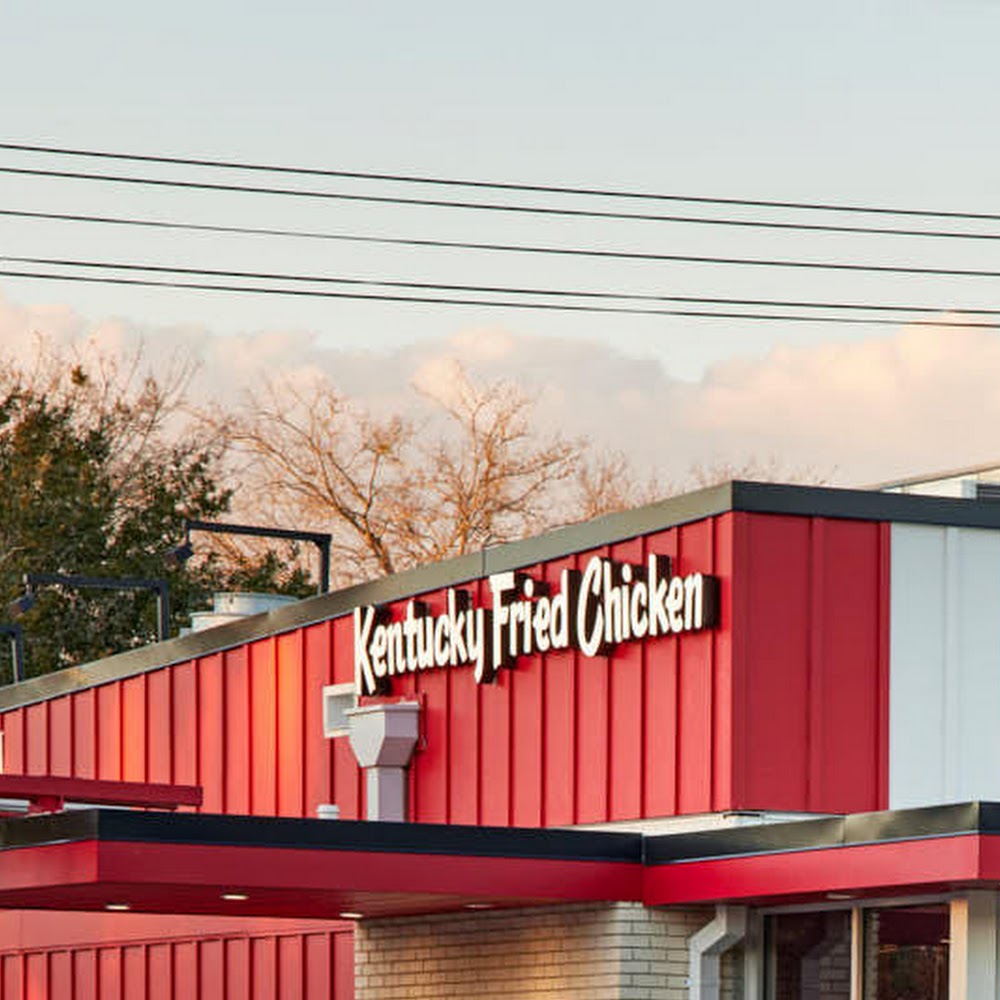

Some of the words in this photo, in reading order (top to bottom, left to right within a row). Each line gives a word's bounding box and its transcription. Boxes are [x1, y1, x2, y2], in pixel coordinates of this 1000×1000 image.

[354, 589, 484, 695] Kentucky
[490, 569, 570, 669] Fried
[577, 553, 704, 657] Chicken
